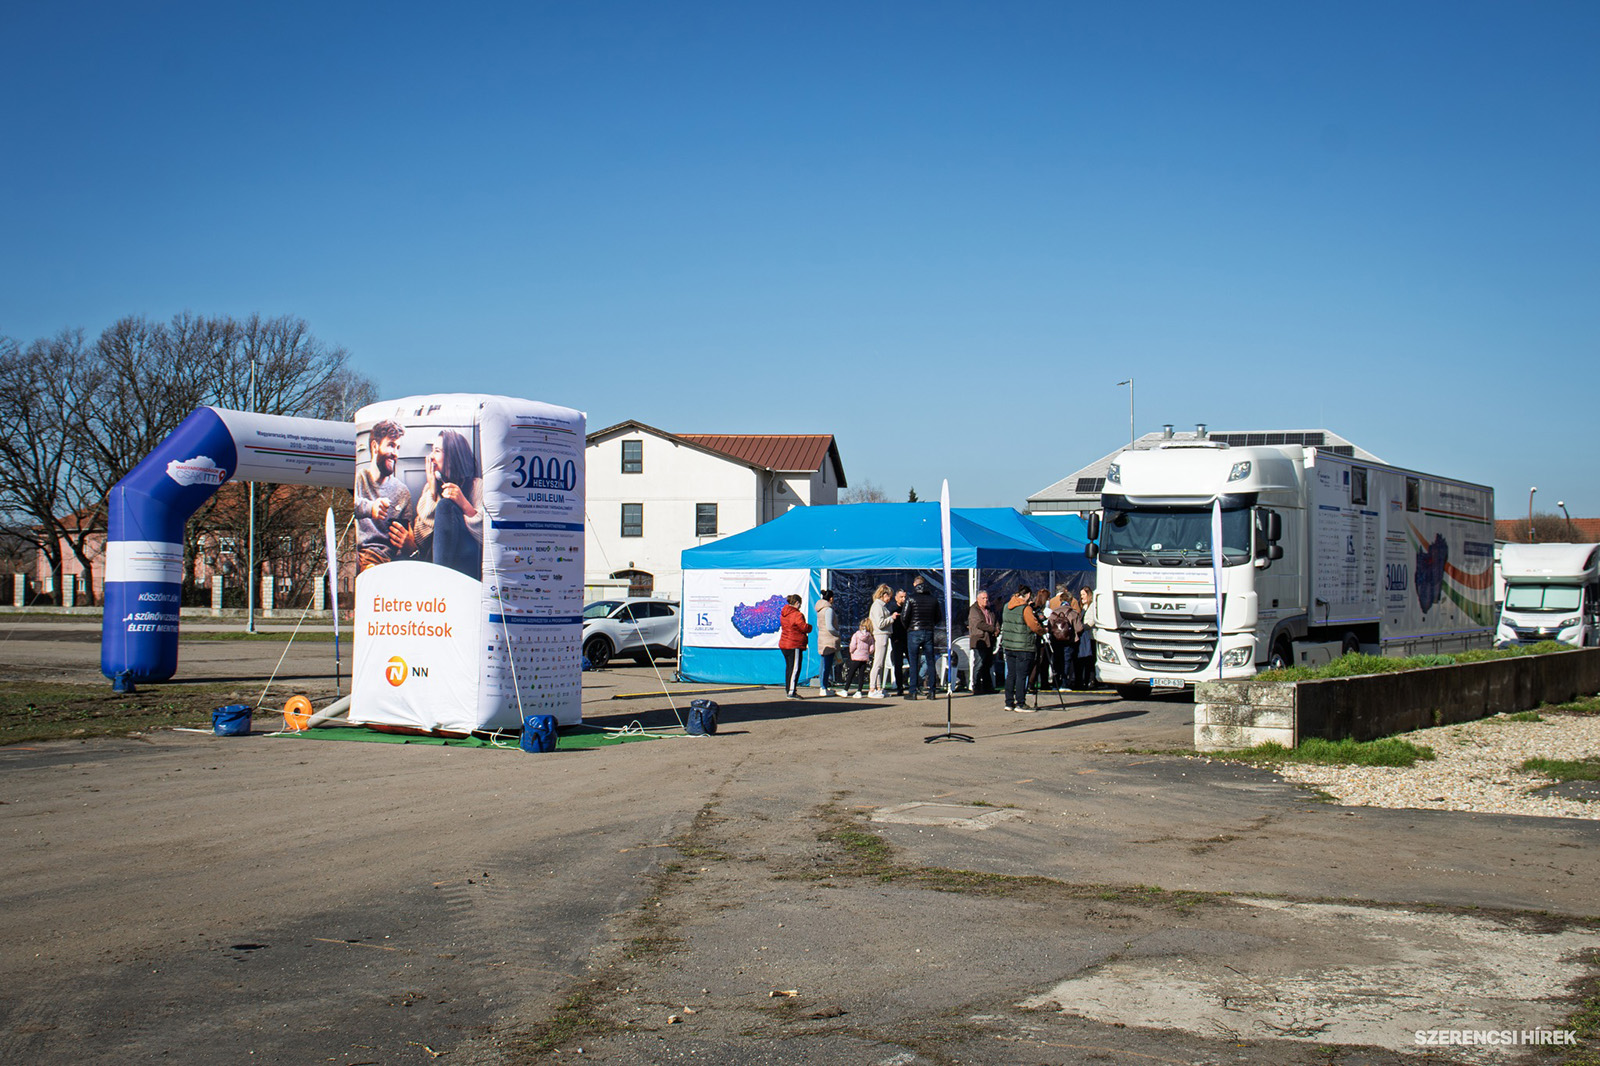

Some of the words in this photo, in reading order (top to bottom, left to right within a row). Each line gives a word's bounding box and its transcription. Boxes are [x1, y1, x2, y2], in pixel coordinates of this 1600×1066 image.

[511, 455, 577, 491] 3000
[526, 493, 565, 503] JUBILEUM
[373, 594, 412, 613] Életre
[416, 597, 446, 613] való
[1150, 603, 1187, 611] DAF
[127, 623, 156, 632] ÉLETET
[368, 620, 452, 638] biztosítások
[412, 667, 429, 677] NN
